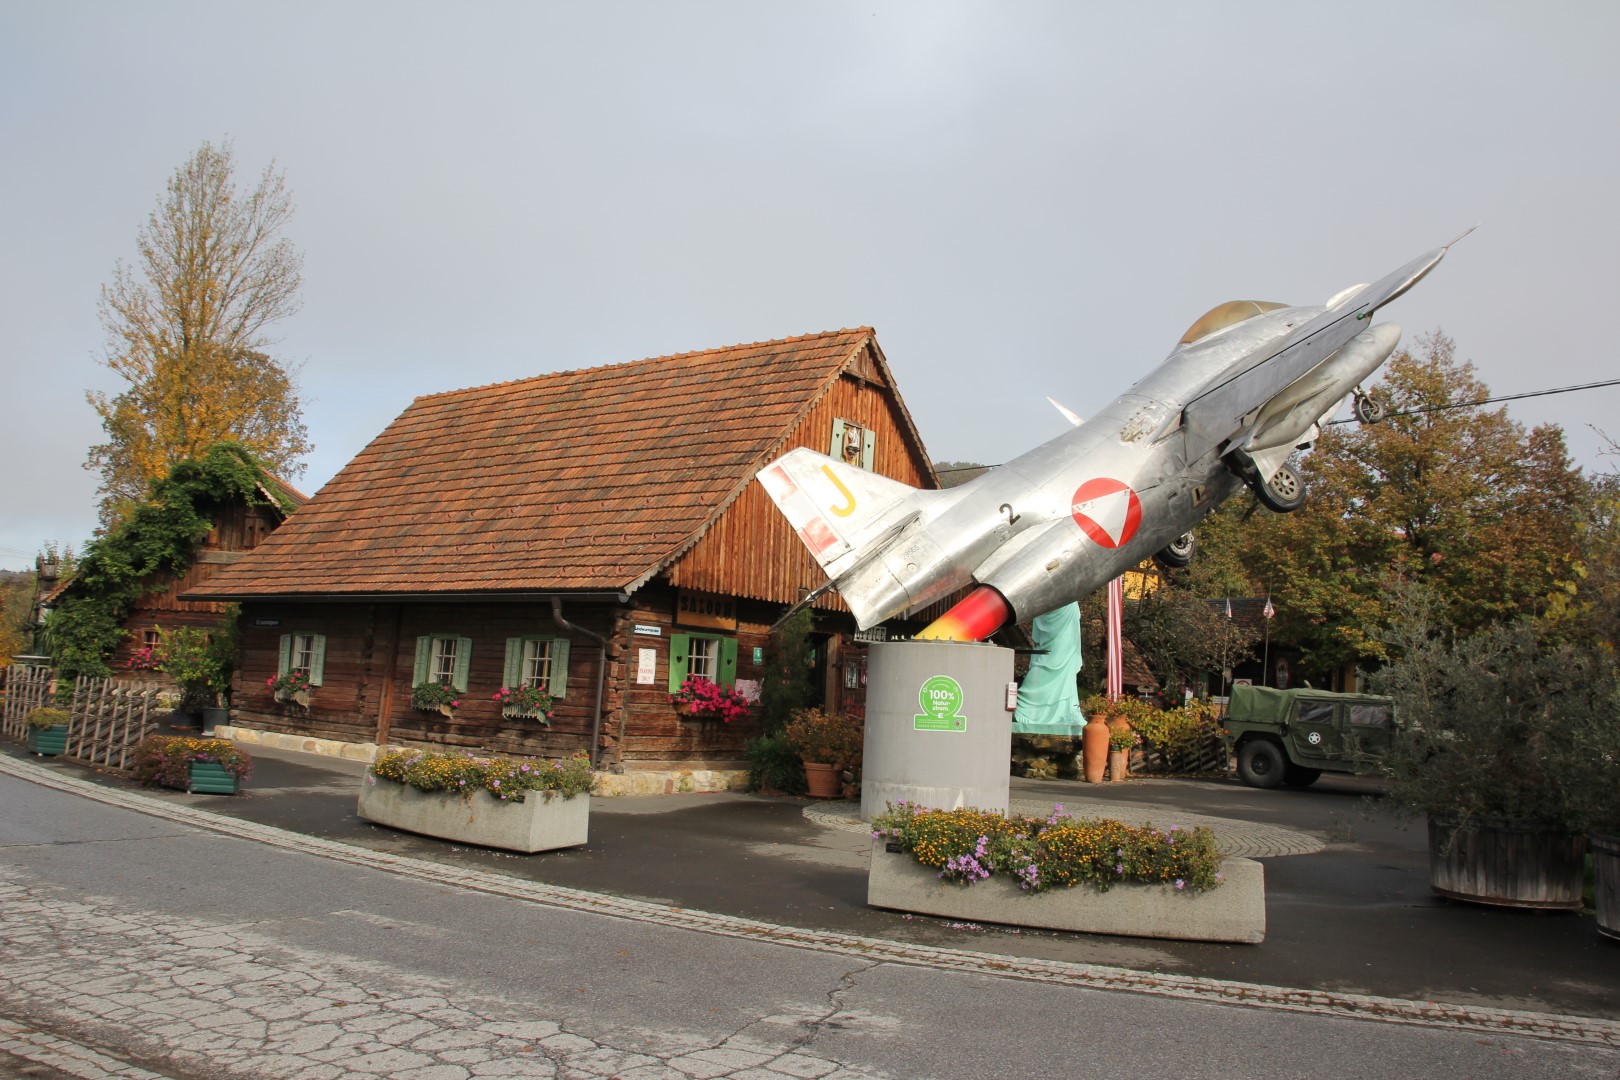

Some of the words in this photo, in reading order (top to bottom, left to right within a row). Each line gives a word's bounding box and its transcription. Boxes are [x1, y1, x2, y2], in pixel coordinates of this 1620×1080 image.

[820, 464, 856, 517] J
[999, 503, 1021, 526] 2
[929, 690, 954, 700] 100%
